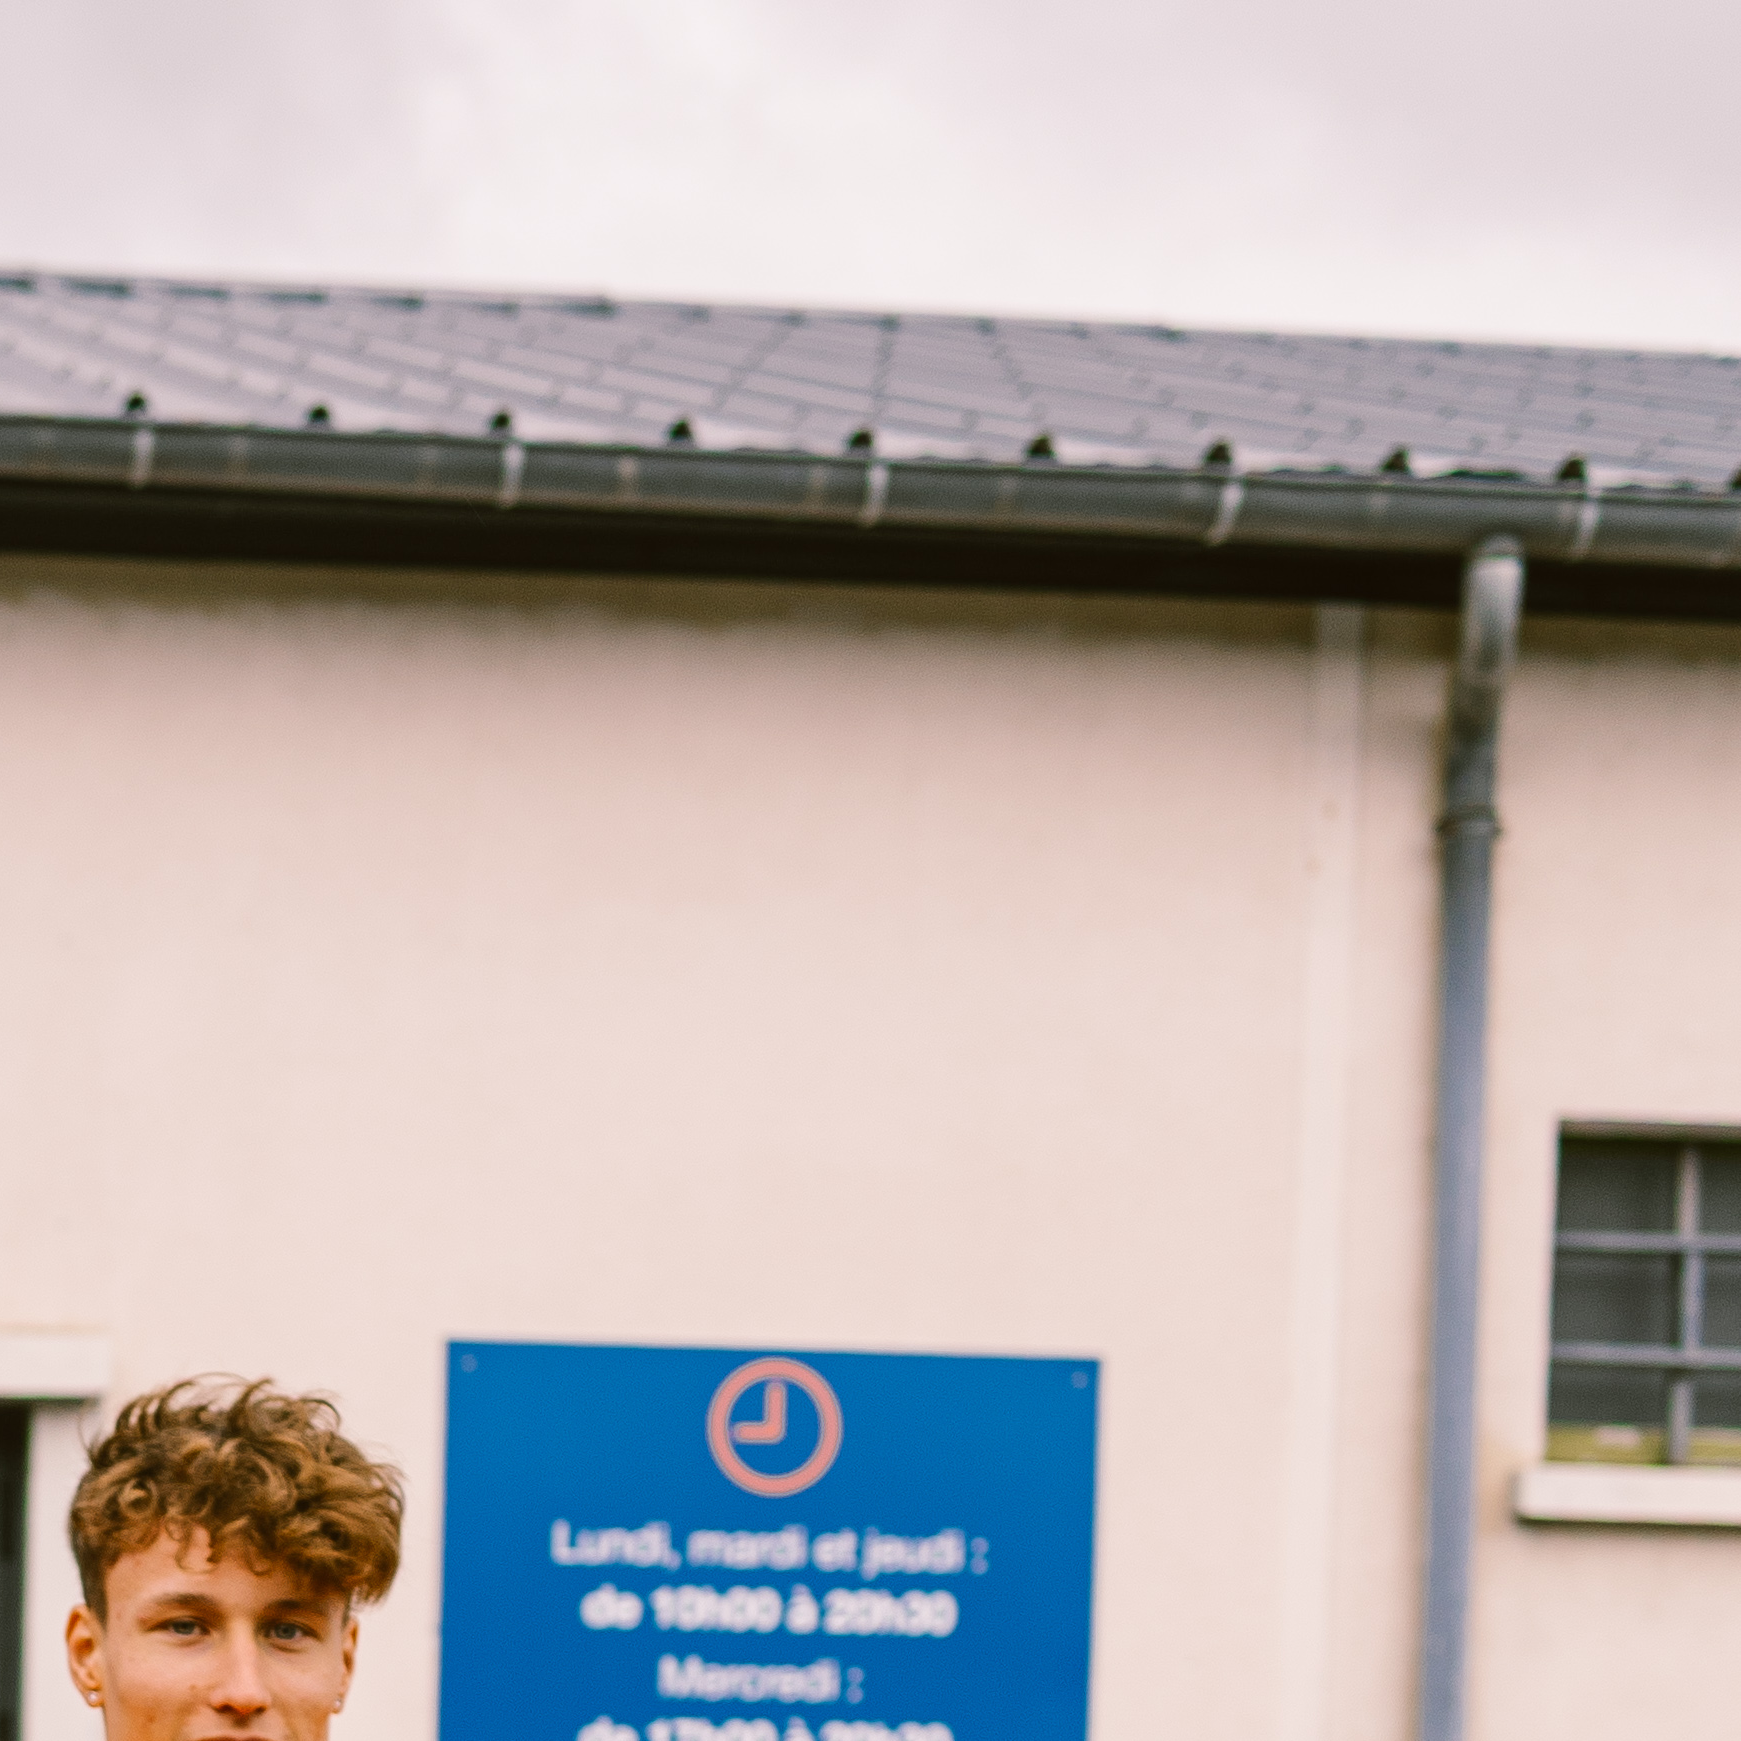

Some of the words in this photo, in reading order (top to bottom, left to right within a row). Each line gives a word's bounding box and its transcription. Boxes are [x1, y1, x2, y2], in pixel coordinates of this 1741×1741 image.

[552, 1521, 680, 1567] Lundi,
[688, 1526, 808, 1569] mardi
[813, 1530, 857, 1570] et
[581, 1584, 643, 1629] de
[785, 1586, 819, 1633] à
[658, 1656, 840, 1702] Mercredi
